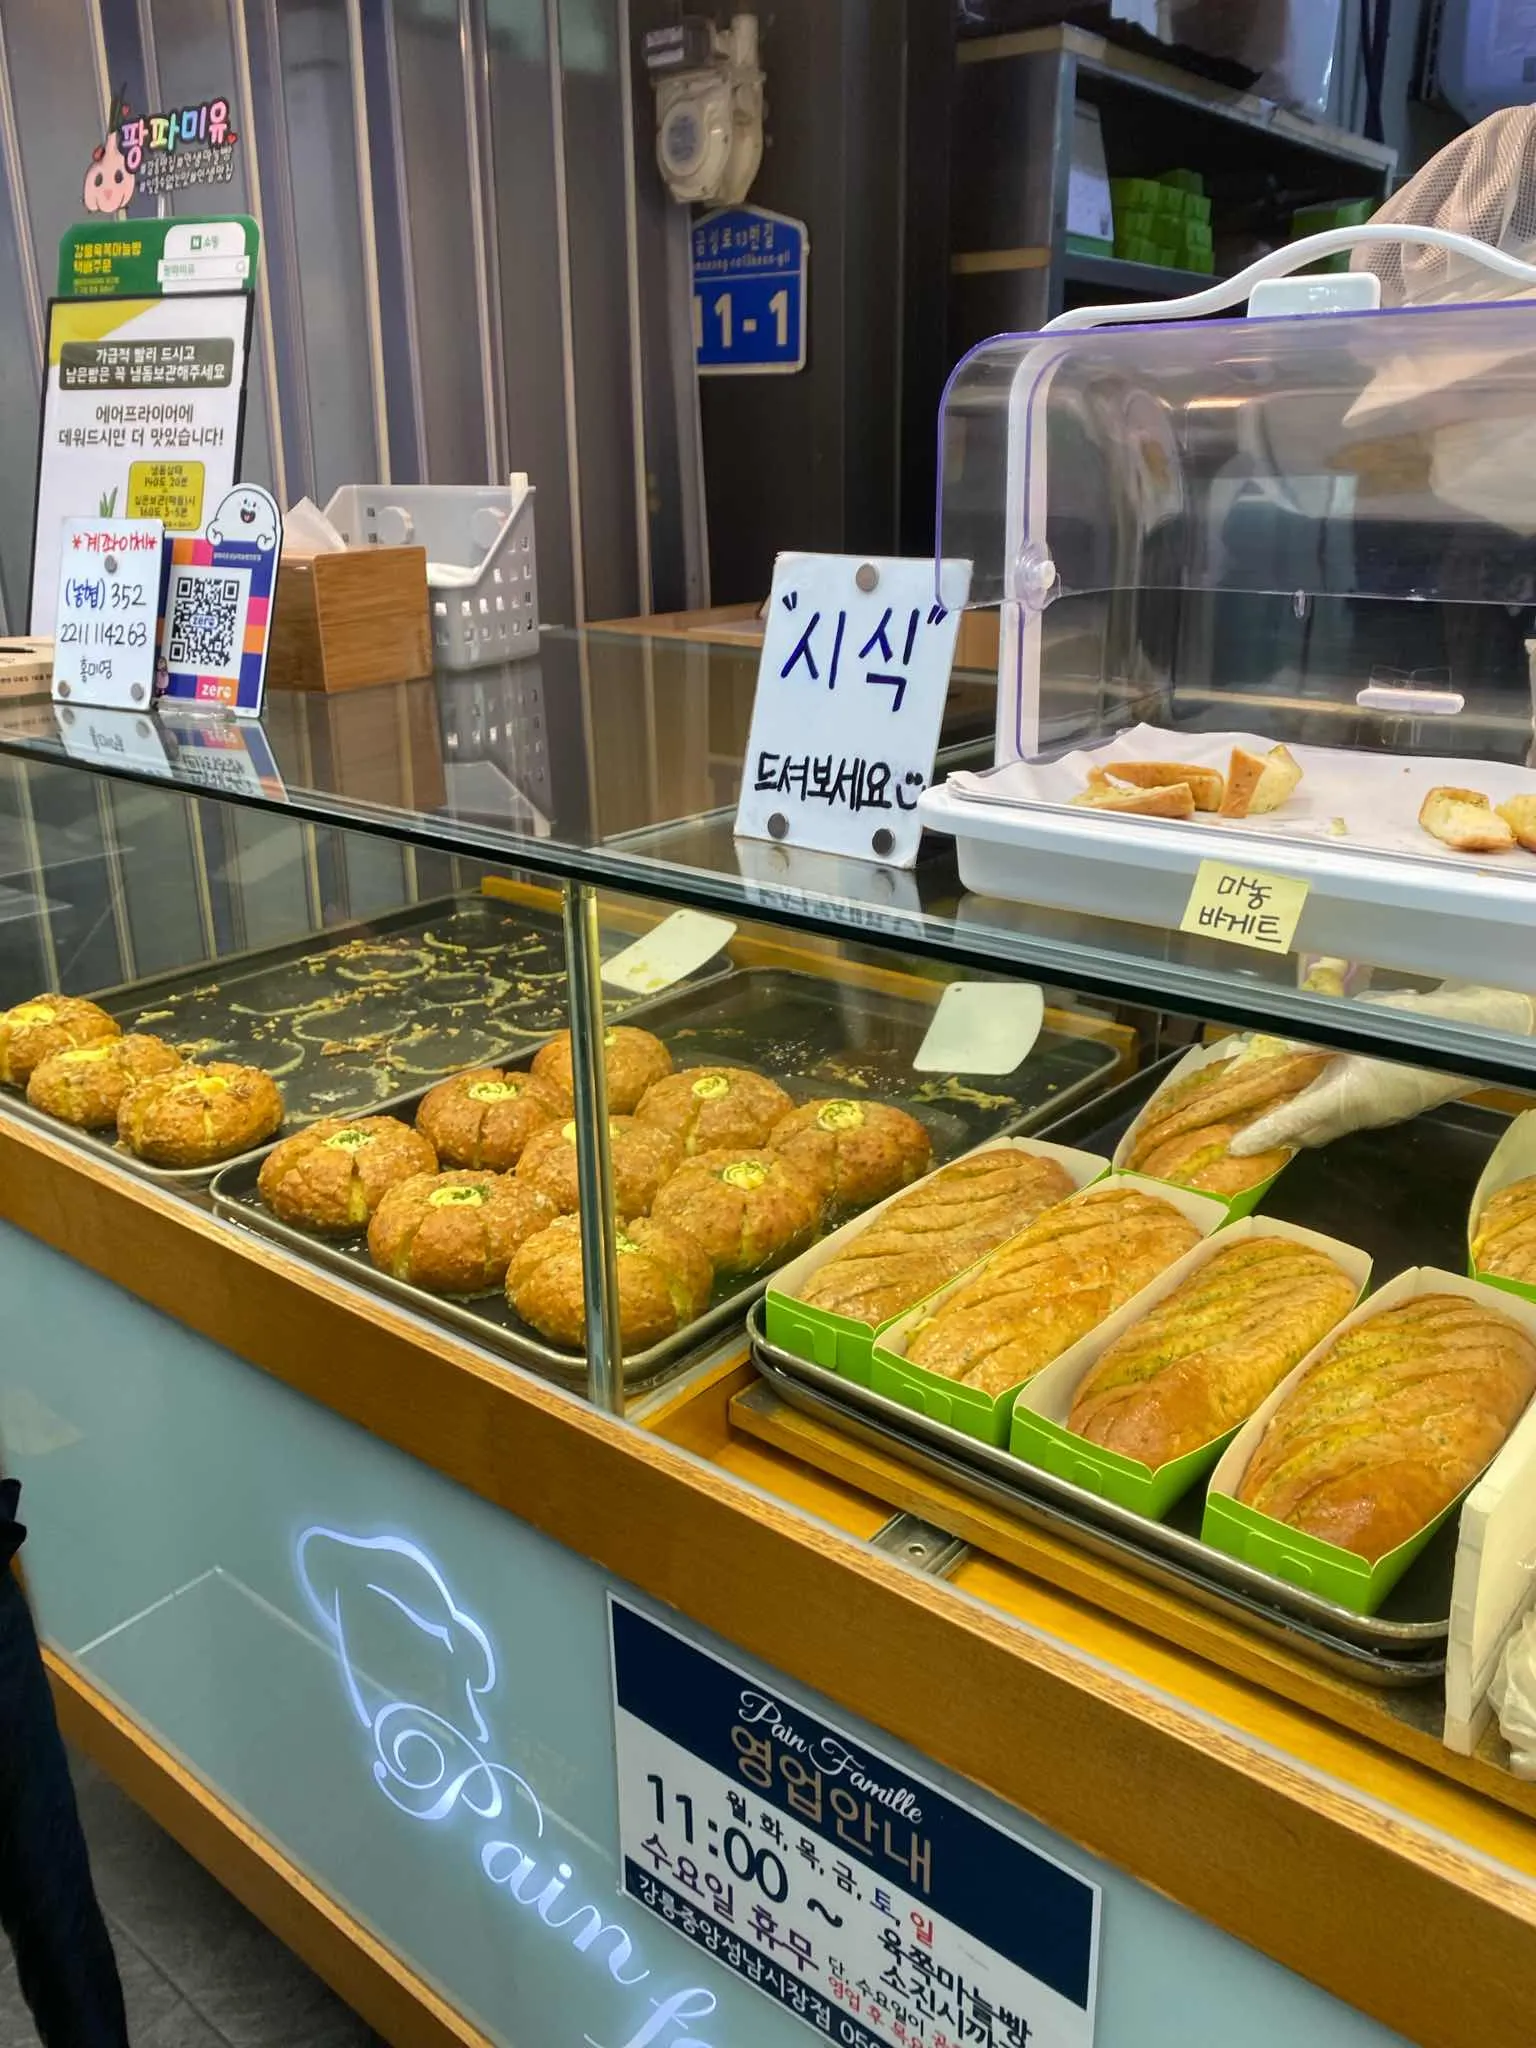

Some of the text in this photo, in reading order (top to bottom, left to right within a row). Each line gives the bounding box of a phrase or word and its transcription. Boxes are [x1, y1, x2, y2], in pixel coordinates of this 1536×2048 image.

[122, 100, 227, 170] 팡파미유
[66, 363, 225, 385] 남은빵은 꼭 냉동보관해주세요
[96, 345, 195, 365] 가급적 빨리 드시고
[59, 427, 224, 448] 데워드시면 더 맛있습니다!
[96, 404, 194, 424] 에어프라이어에
[111, 582, 146, 610] 352
[754, 751, 892, 812] 드셔보세요
[1199, 906, 1282, 943] 바게트
[739, 1691, 923, 1824] Pain Famille
[647, 1774, 789, 1903] 11:00
[731, 1725, 931, 1895] 영업안내
[640, 1833, 819, 1972] 수요일 휴무
[910, 1911, 933, 1950] 일
[640, 1874, 831, 2031] 강릉중앙성남시장점
[828, 1976, 860, 2013] 영업
[868, 2004, 885, 2025] 후
[856, 1979, 924, 2037] 수요일이
[878, 1928, 1033, 2048] 육쪽마늘빵
[880, 1965, 1012, 2048] 소진시까
